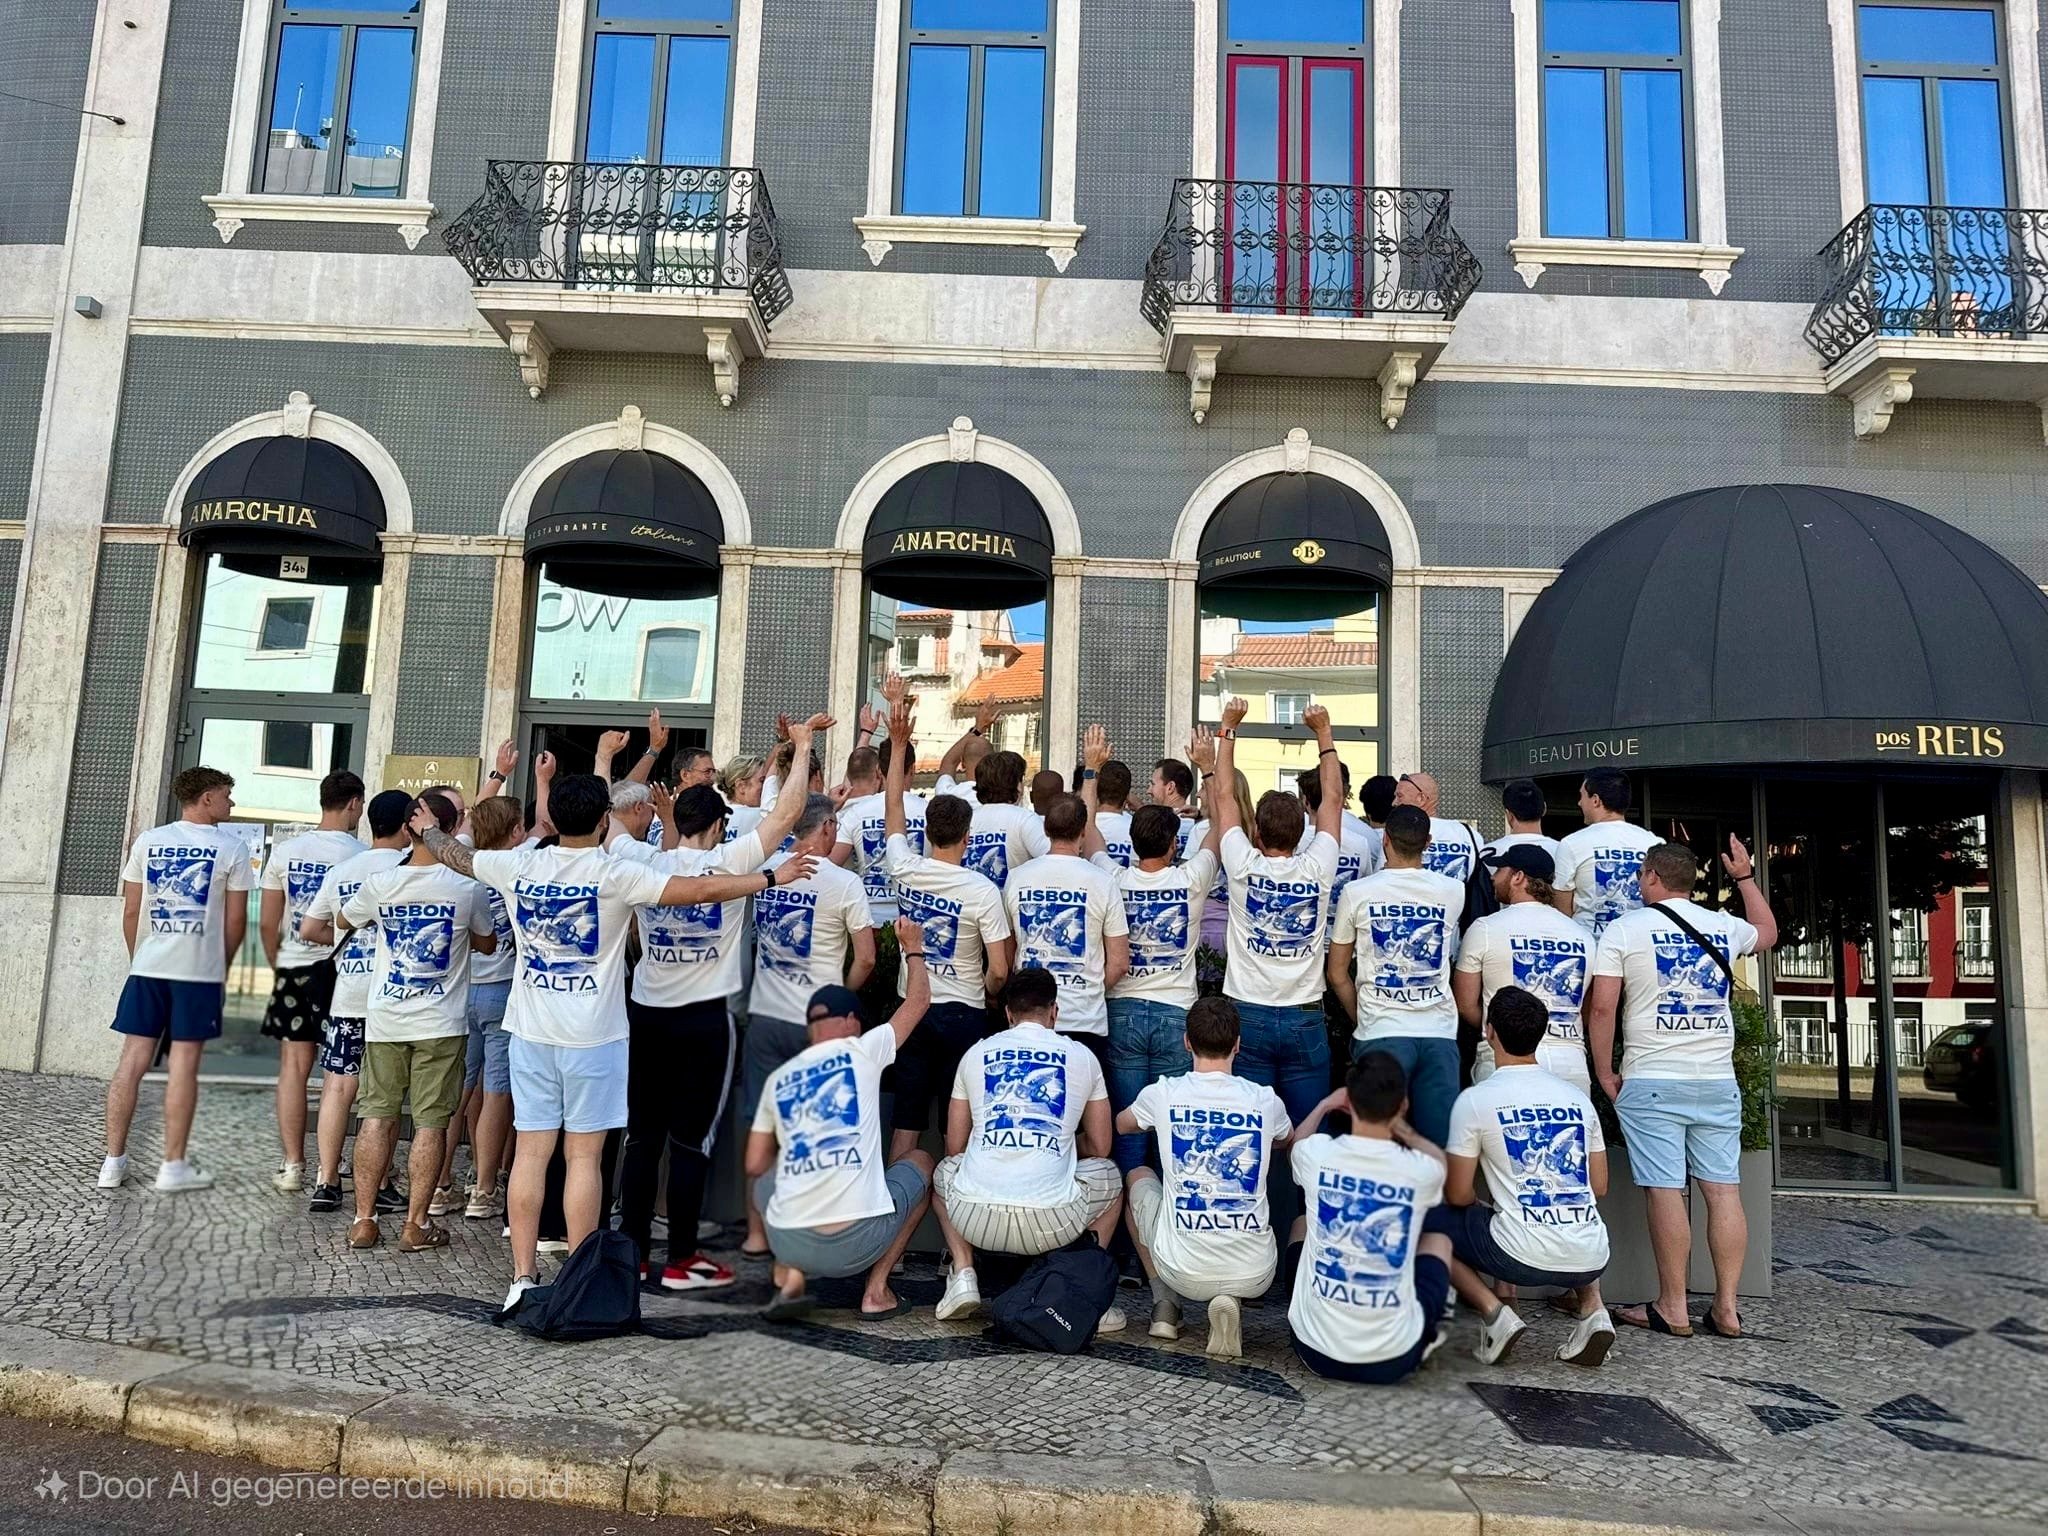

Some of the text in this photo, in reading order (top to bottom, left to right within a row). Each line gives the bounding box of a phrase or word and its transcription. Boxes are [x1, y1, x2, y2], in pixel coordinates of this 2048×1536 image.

[190, 501, 317, 528] ANARCHIA
[529, 522, 696, 546] RESTAURANTE italiano
[891, 531, 1016, 558] ANARCHIA
[282, 561, 306, 573] 34b
[1215, 550, 1262, 566] BEAUTIQUE
[1529, 738, 1640, 764] BEAUTIQUE
[1875, 725, 2004, 758] DOS REIS
[148, 847, 218, 858] LISBON
[514, 880, 599, 897] LISBON
[1247, 875, 1320, 894] LISBON
[897, 883, 964, 915] LISBON
[1018, 890, 1087, 903] LISBON
[378, 905, 456, 918] LISBON
[1369, 905, 1445, 919] LISBON
[151, 920, 204, 936] NALTA
[647, 946, 719, 962] NALTA
[1510, 938, 1585, 954] LISBON
[522, 969, 598, 992] NALTA
[1375, 986, 1444, 1003] NALTA
[1656, 1015, 1729, 1030] NALTA
[983, 1050, 1066, 1066] LISBON
[1169, 1109, 1262, 1129] LISBON
[1497, 1107, 1583, 1125] LISBON
[981, 1131, 1060, 1152] NALTA
[1318, 1171, 1415, 1202] LISBON
[1176, 1211, 1260, 1230] NALTA
[1522, 1205, 1597, 1225] NALTA
[1311, 1276, 1401, 1308] NALTA
[1053, 1312, 1072, 1331] NALTA
